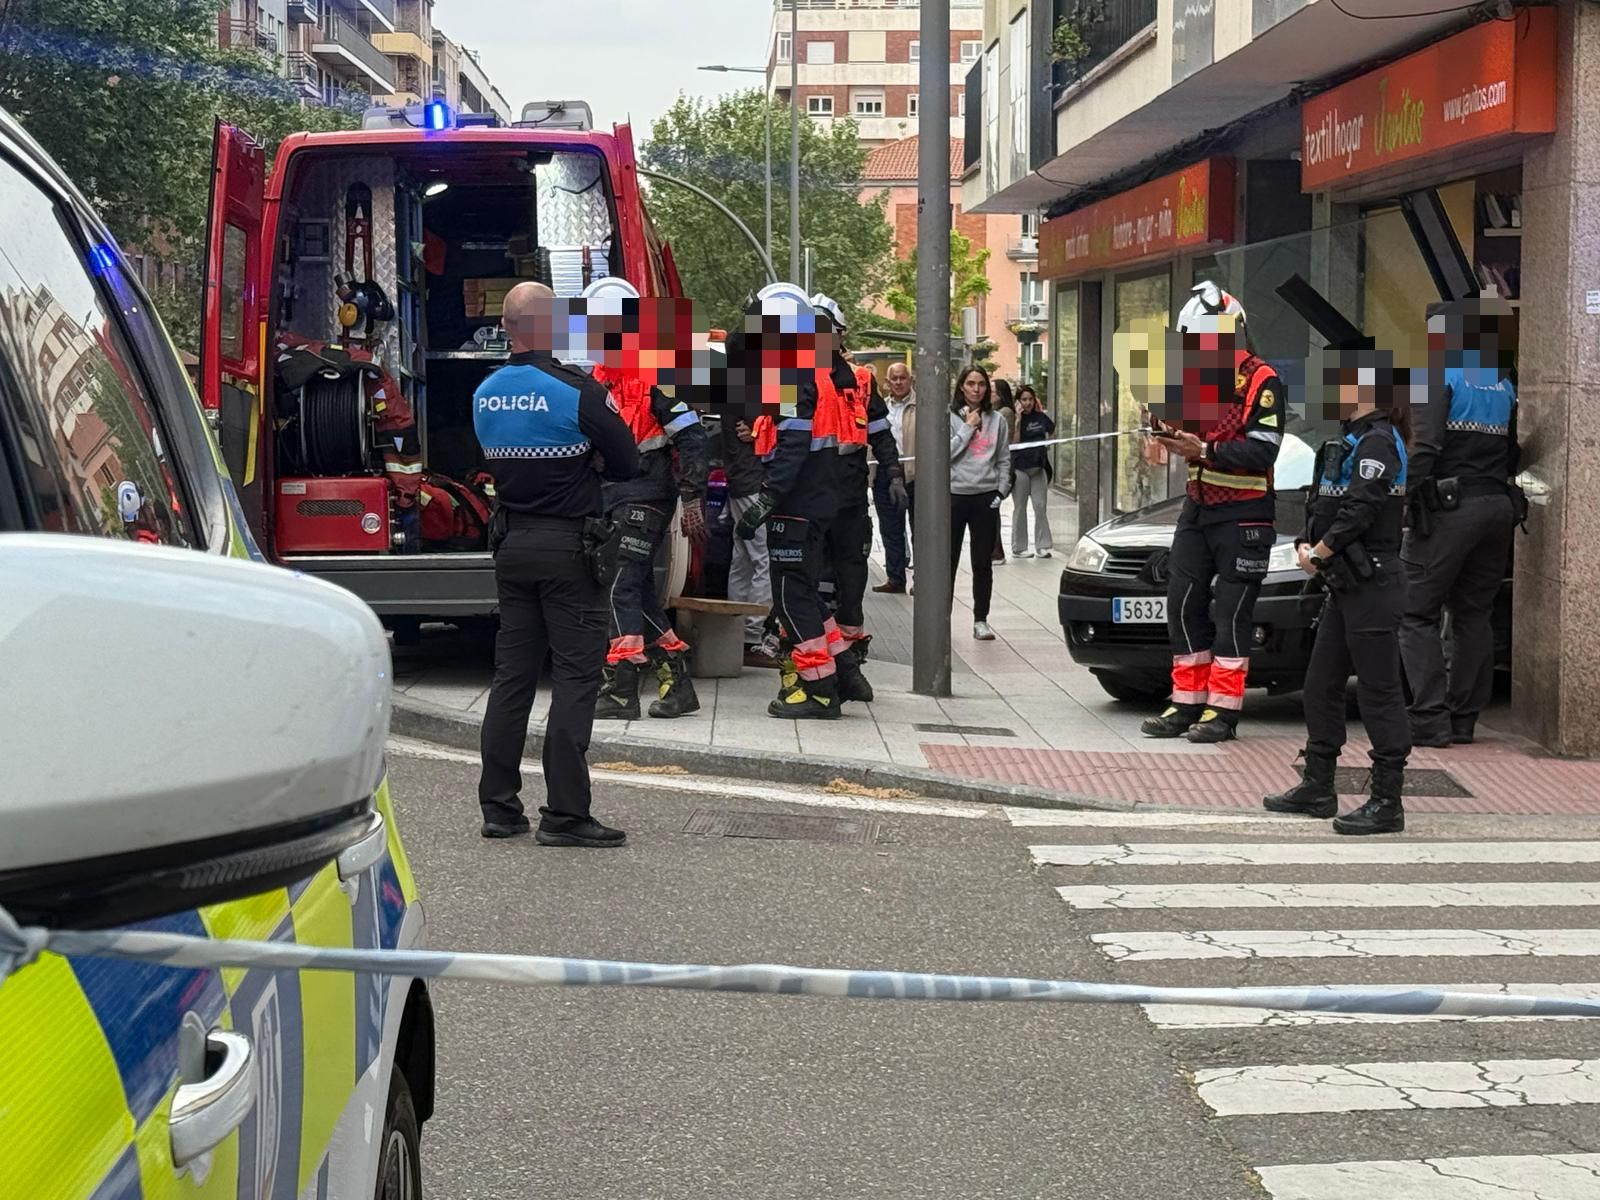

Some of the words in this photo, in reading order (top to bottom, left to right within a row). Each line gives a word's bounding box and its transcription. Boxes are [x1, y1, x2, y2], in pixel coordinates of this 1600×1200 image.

[1305, 109, 1332, 167] textil
[1334, 108, 1364, 168] hogar
[1374, 78, 1425, 156] Javitos
[1443, 80, 1507, 124] www.javitos.com
[478, 392, 550, 413] POLICÍA
[620, 536, 652, 550] OMBEROS
[770, 548, 803, 558] OMBEROS
[1123, 600, 1164, 619] 5632
